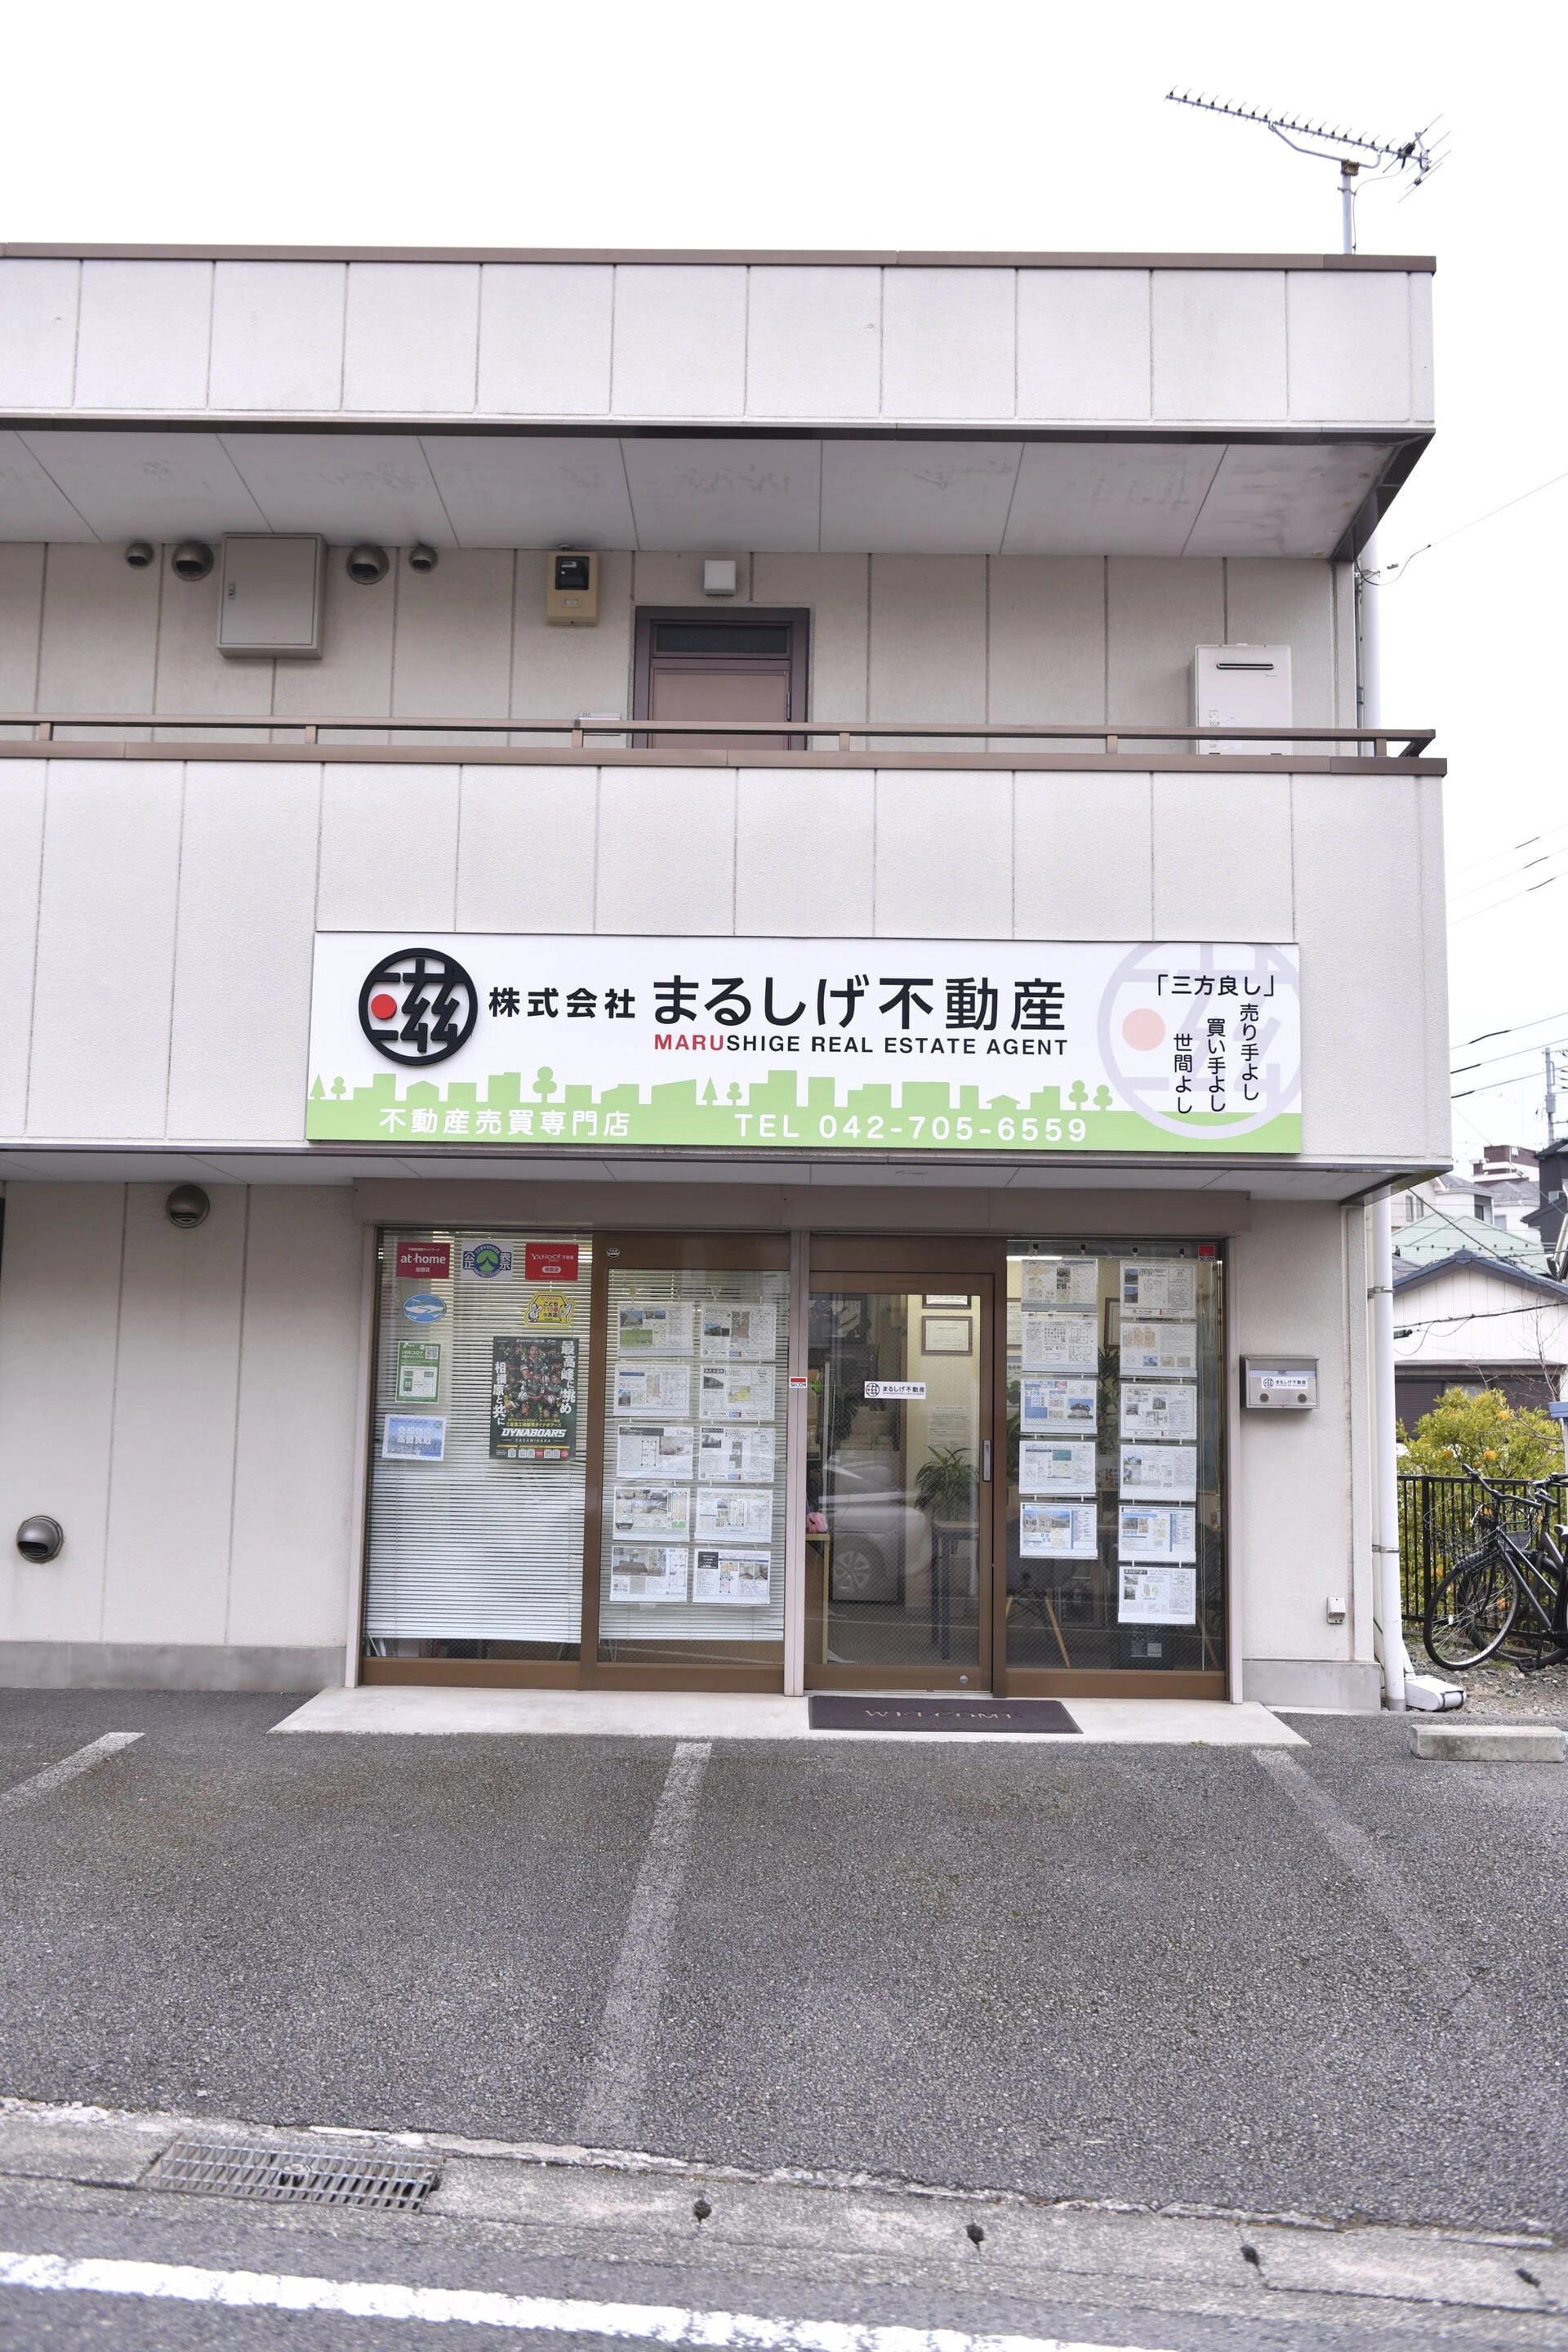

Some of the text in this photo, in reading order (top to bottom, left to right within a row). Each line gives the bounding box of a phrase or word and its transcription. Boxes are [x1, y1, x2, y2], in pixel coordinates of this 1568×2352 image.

[1157, 974, 1276, 997] 「三方良し」
[488, 974, 1067, 1031] 株式会社 まるしげ不動産
[654, 1034, 1068, 1056] MARUSHIGE REAL ESTATE AGENT
[1240, 1004, 1259, 1101] 売り手よし
[1174, 1034, 1193, 1114] 世間よし
[1207, 1018, 1226, 1112] 買い手よし
[379, 1108, 631, 1137] 不動産売買専門店
[735, 1113, 1087, 1143] TEL 042-705-6559
[400, 1253, 446, 1264] at home
[464, 1252, 475, 1269] 公正
[501, 1428, 567, 1437] DYNABOARS
